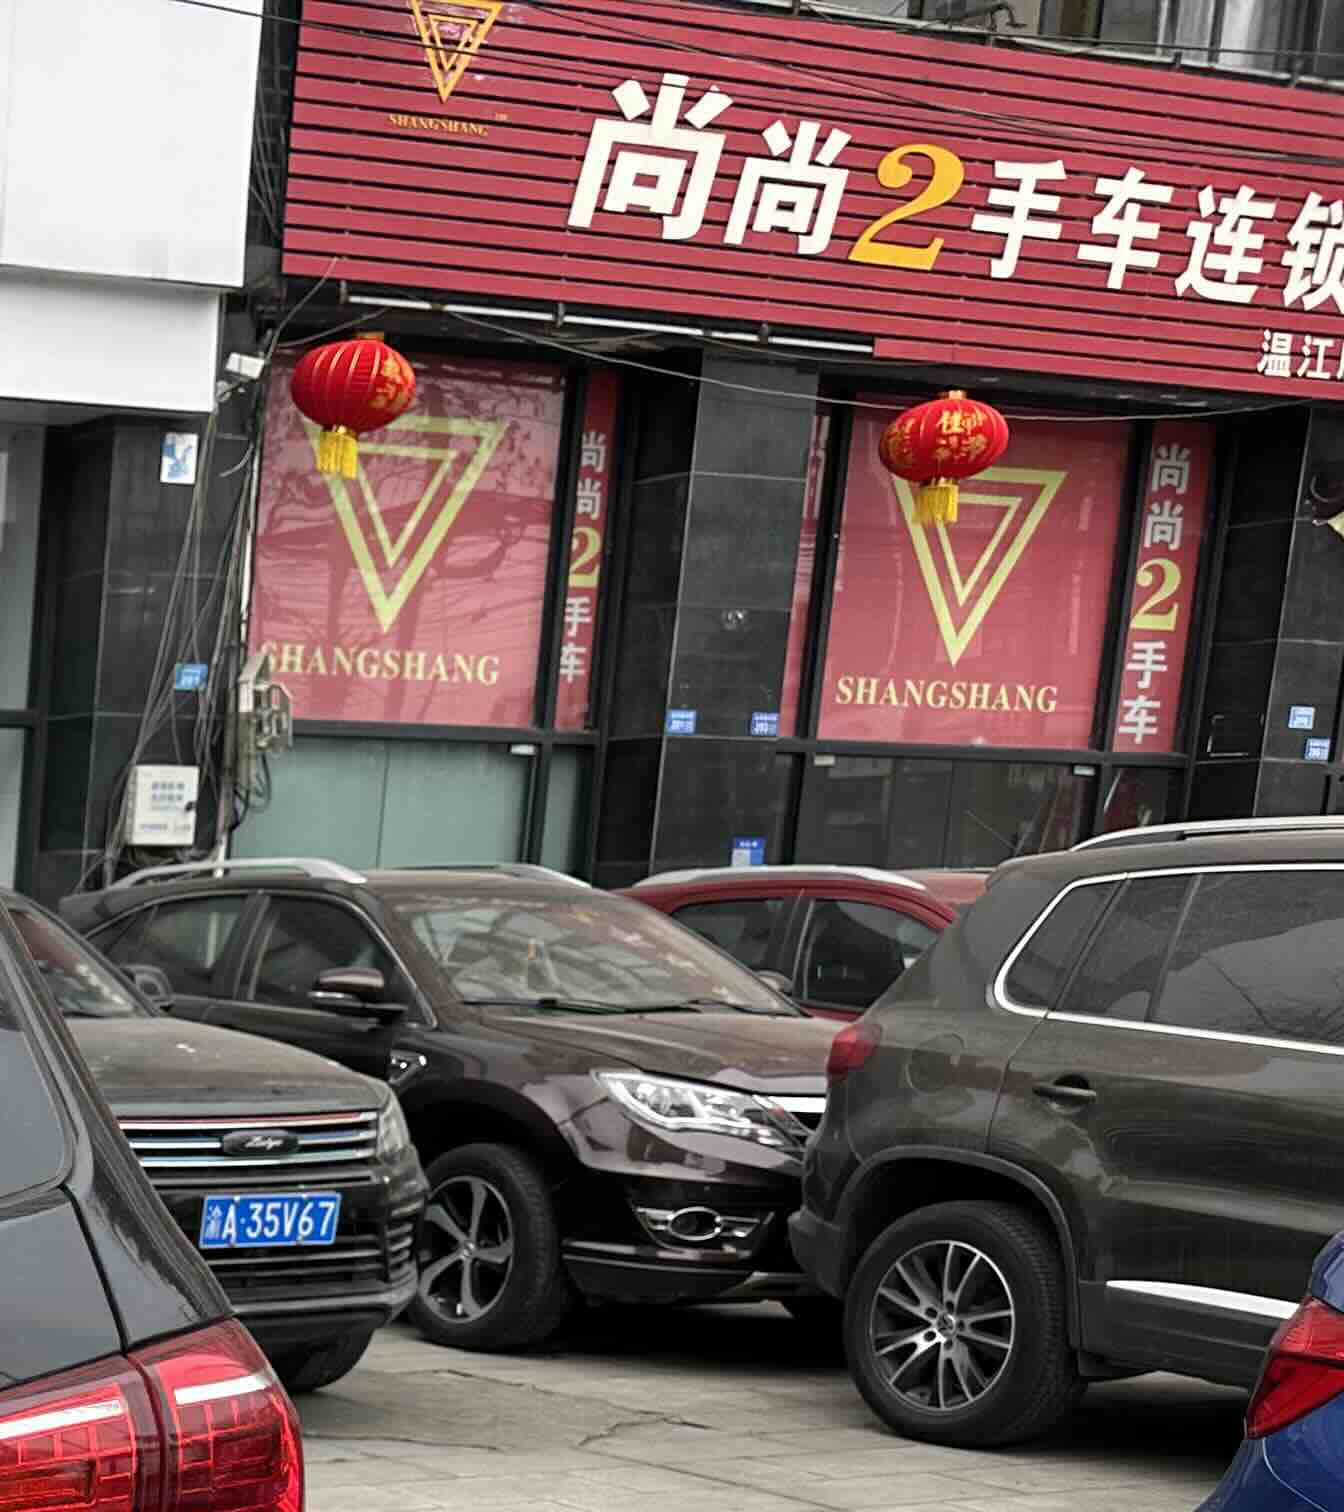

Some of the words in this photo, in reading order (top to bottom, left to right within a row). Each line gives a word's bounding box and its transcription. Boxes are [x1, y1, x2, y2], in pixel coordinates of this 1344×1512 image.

[389, 113, 489, 136] SHANGSHANG
[1257, 329, 1344, 379] 温江
[559, 430, 606, 682] 尚尚2手车
[1118, 443, 1191, 744] 尚尚2手车
[260, 641, 499, 685] SHANGSHANG
[835, 676, 1059, 713] SHANGSHANG
